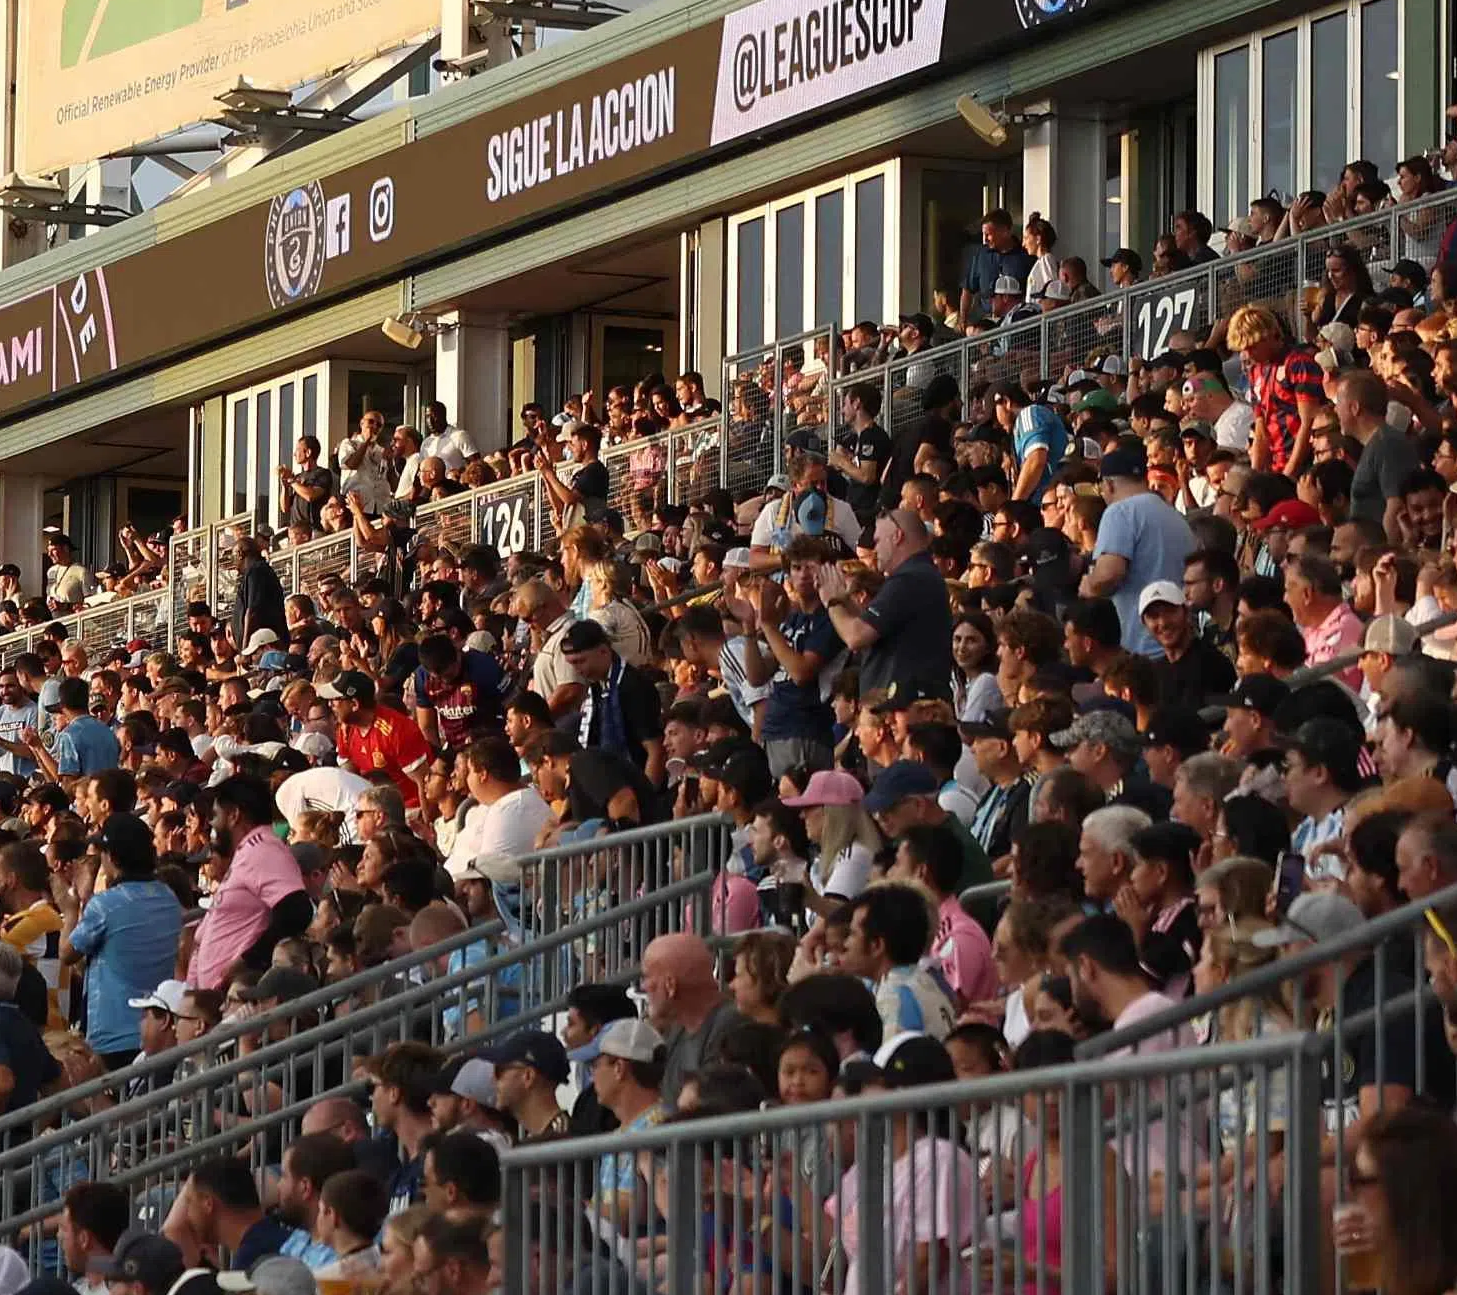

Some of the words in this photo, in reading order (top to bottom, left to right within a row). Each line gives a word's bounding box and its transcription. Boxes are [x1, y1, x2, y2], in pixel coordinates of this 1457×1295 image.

[56, 97, 91, 125] Official
[92, 80, 142, 115] Renewable
[143, 67, 178, 99] Energy
[180, 52, 220, 81] Provider
[221, 47, 233, 66] of
[234, 42, 249, 62] the
[308, 7, 335, 32] Union
[337, 0, 355, 20] and
[486, 120, 552, 202] SIGUE
[555, 106, 586, 176] LA
[587, 67, 676, 162] ACCION
[1137, 287, 1196, 362] 127
[482, 497, 526, 558] 126
